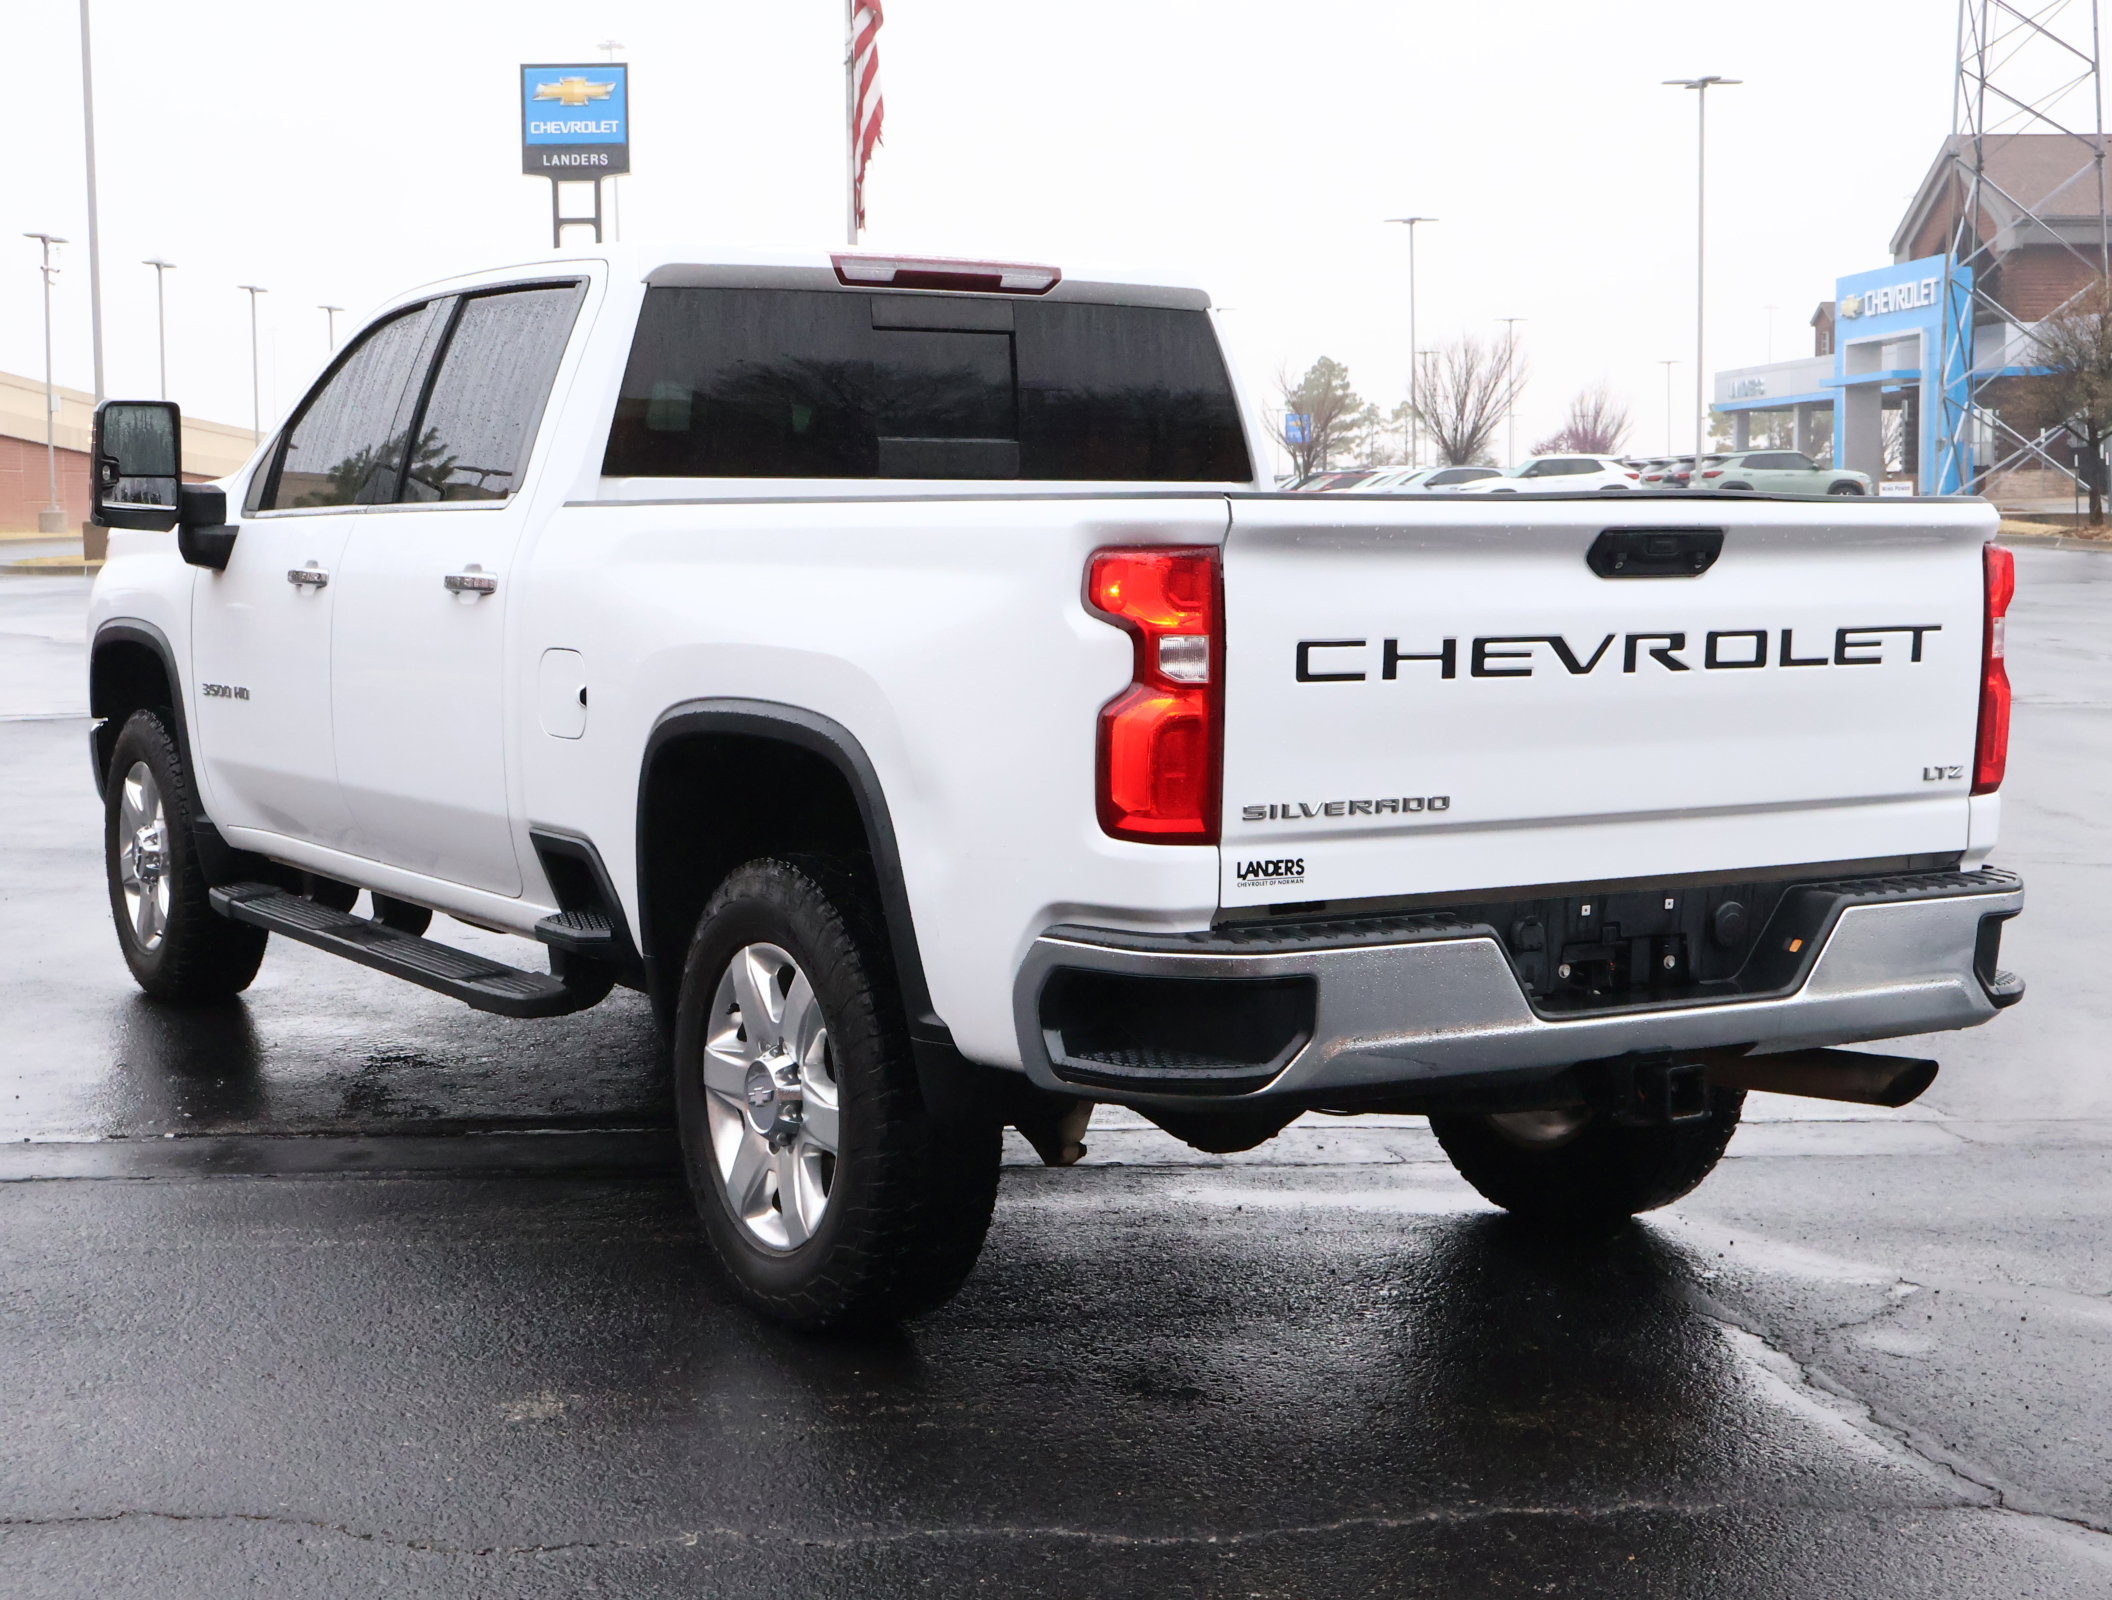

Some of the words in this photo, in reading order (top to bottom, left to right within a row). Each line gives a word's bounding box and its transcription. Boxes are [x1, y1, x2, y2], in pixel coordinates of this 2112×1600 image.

[530, 120, 619, 134] CHEVROLET
[542, 153, 609, 166] LANDERS
[1864, 277, 1939, 317] CHEVROLET
[1295, 624, 1942, 683] CHEVROLET
[202, 683, 232, 698] 3500
[233, 686, 250, 700] HD
[1922, 765, 1964, 781] LTZ
[1242, 795, 1451, 822] SILVERADO
[1236, 858, 1305, 881] LANDERS
[1237, 880, 1268, 888] CHEVROLET
